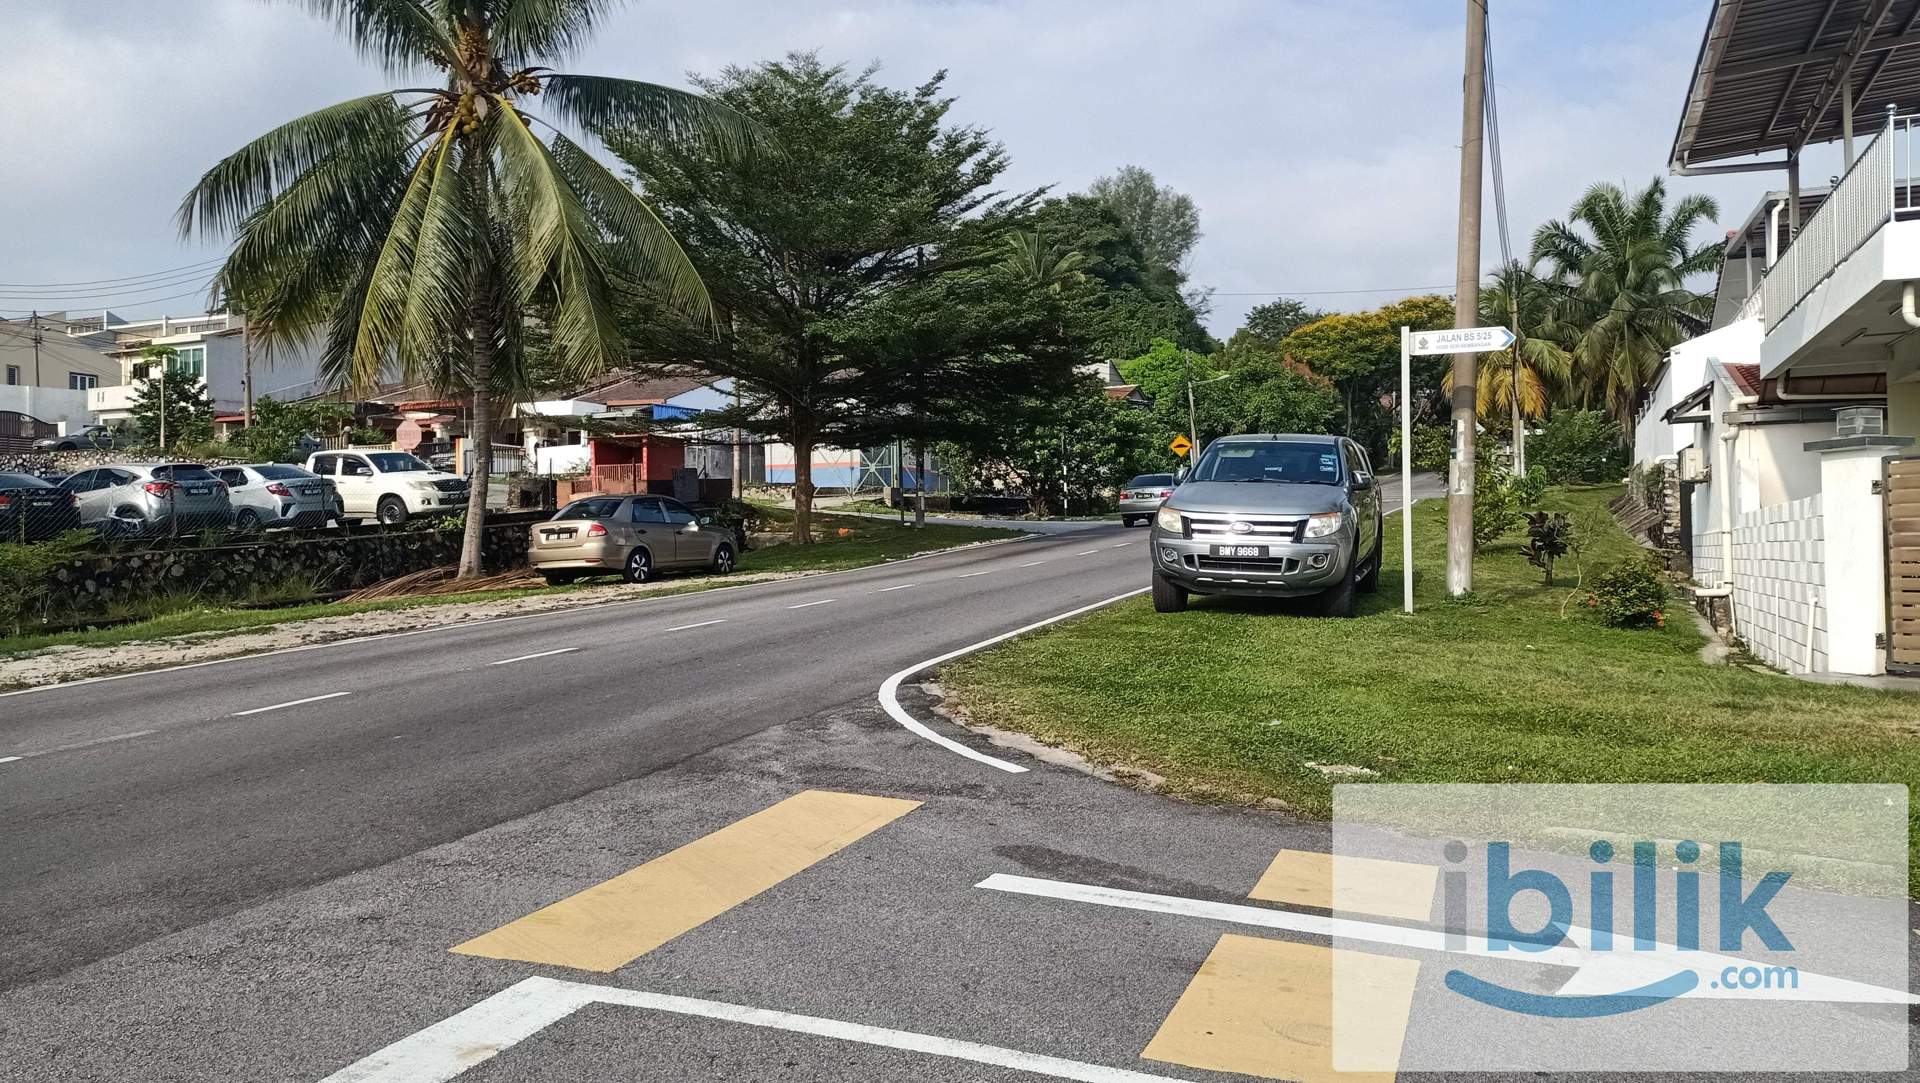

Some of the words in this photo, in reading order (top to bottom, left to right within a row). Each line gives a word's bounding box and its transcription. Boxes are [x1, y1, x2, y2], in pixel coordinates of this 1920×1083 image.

[1436, 333, 1462, 343] JALAN
[1464, 332, 1475, 341] BS
[1476, 331, 1492, 340] 5/25
[1219, 546, 1236, 556] BMY
[1237, 546, 1259, 556] 9668
